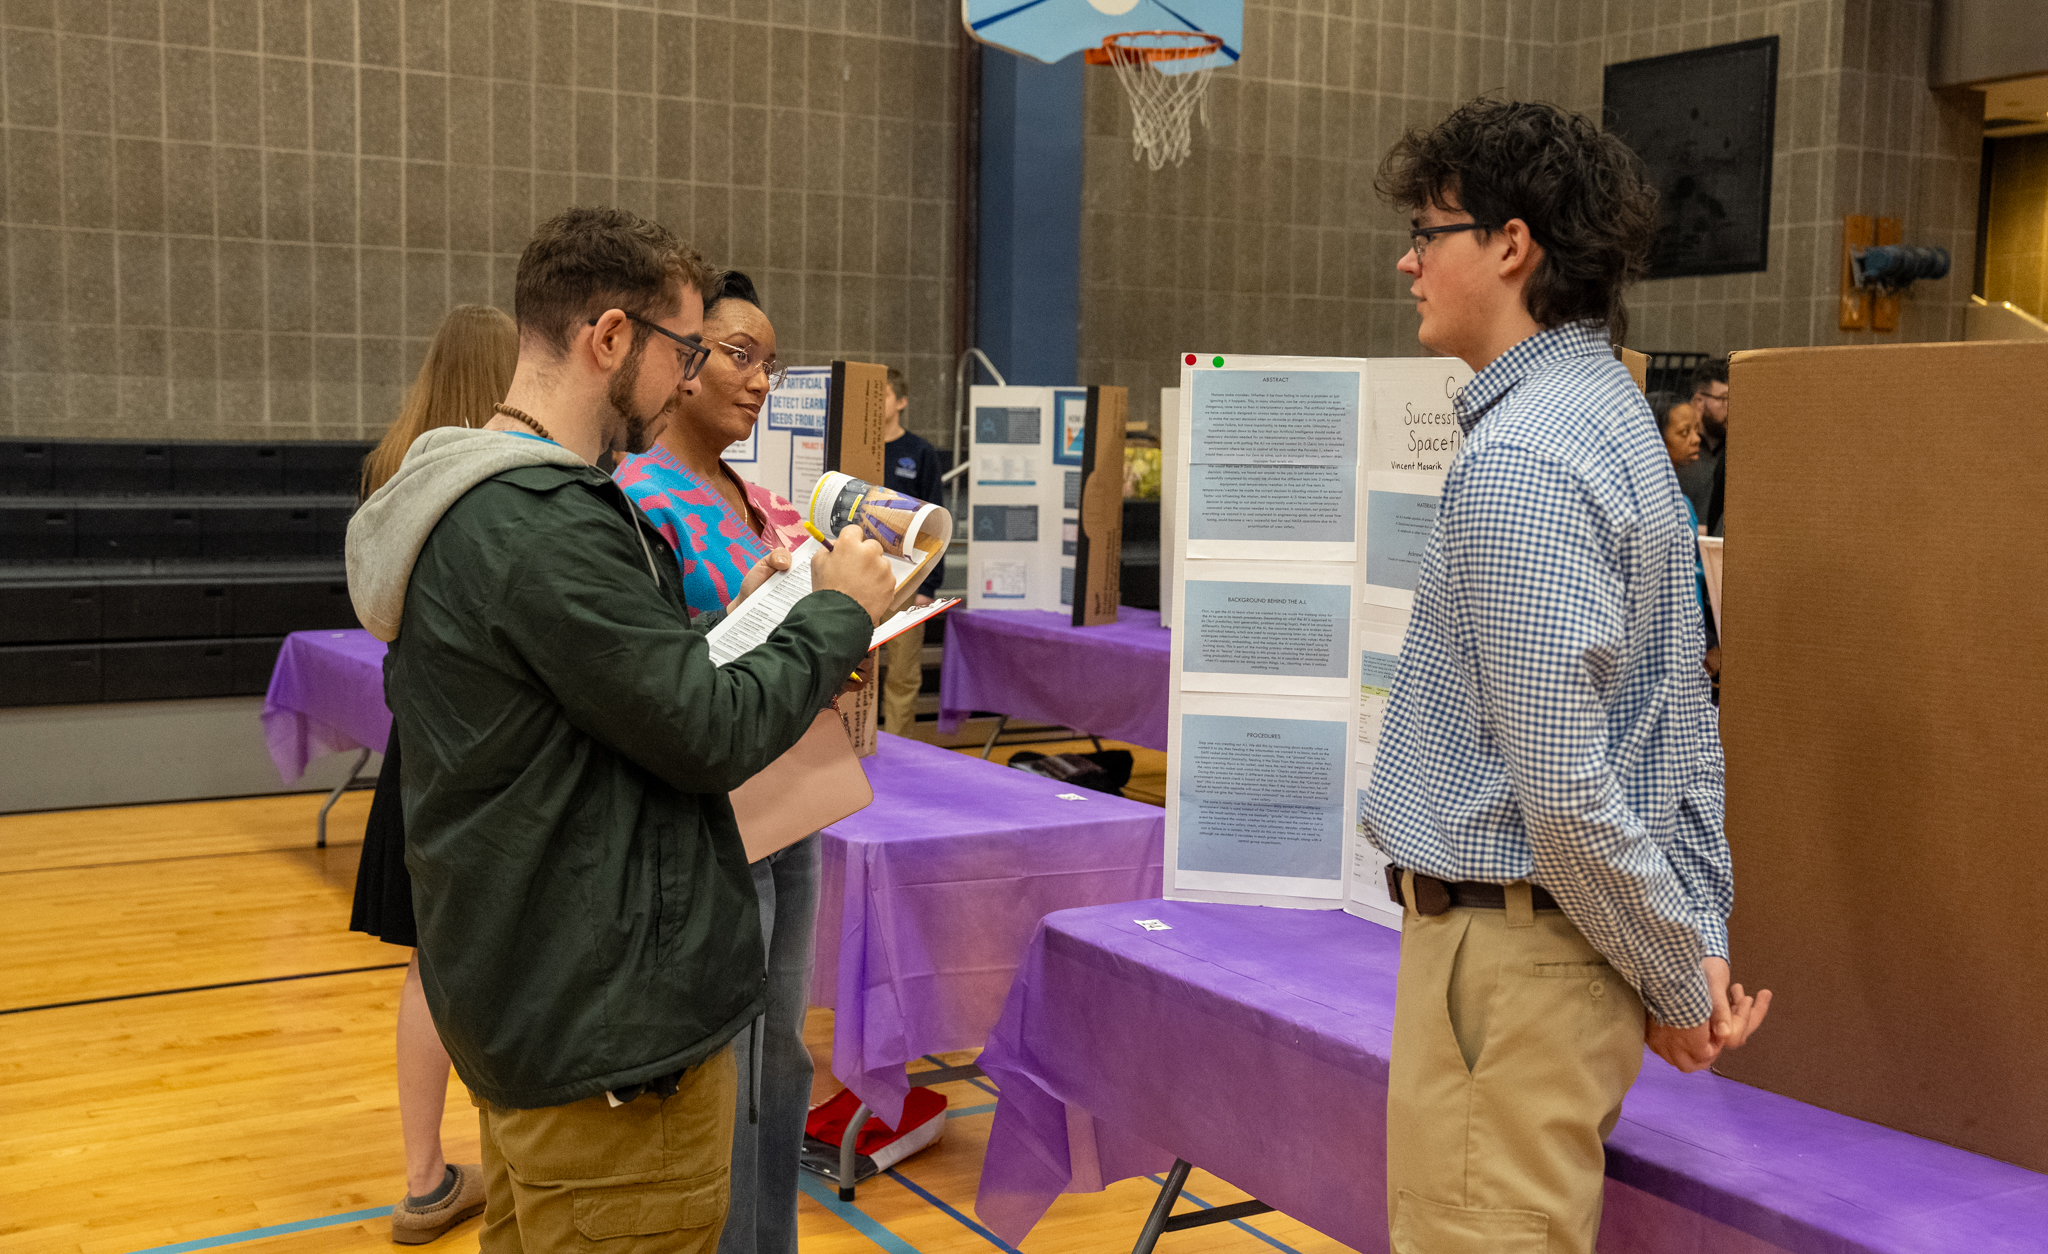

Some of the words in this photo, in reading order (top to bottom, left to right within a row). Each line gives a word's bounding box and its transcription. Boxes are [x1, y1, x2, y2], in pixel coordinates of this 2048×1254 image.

[786, 378, 822, 389] ARTIFICIAL
[773, 396, 800, 409] DETECT
[771, 412, 793, 425] NEEDS
[795, 414, 815, 427] FROM
[1391, 461, 1415, 470] Vincent
